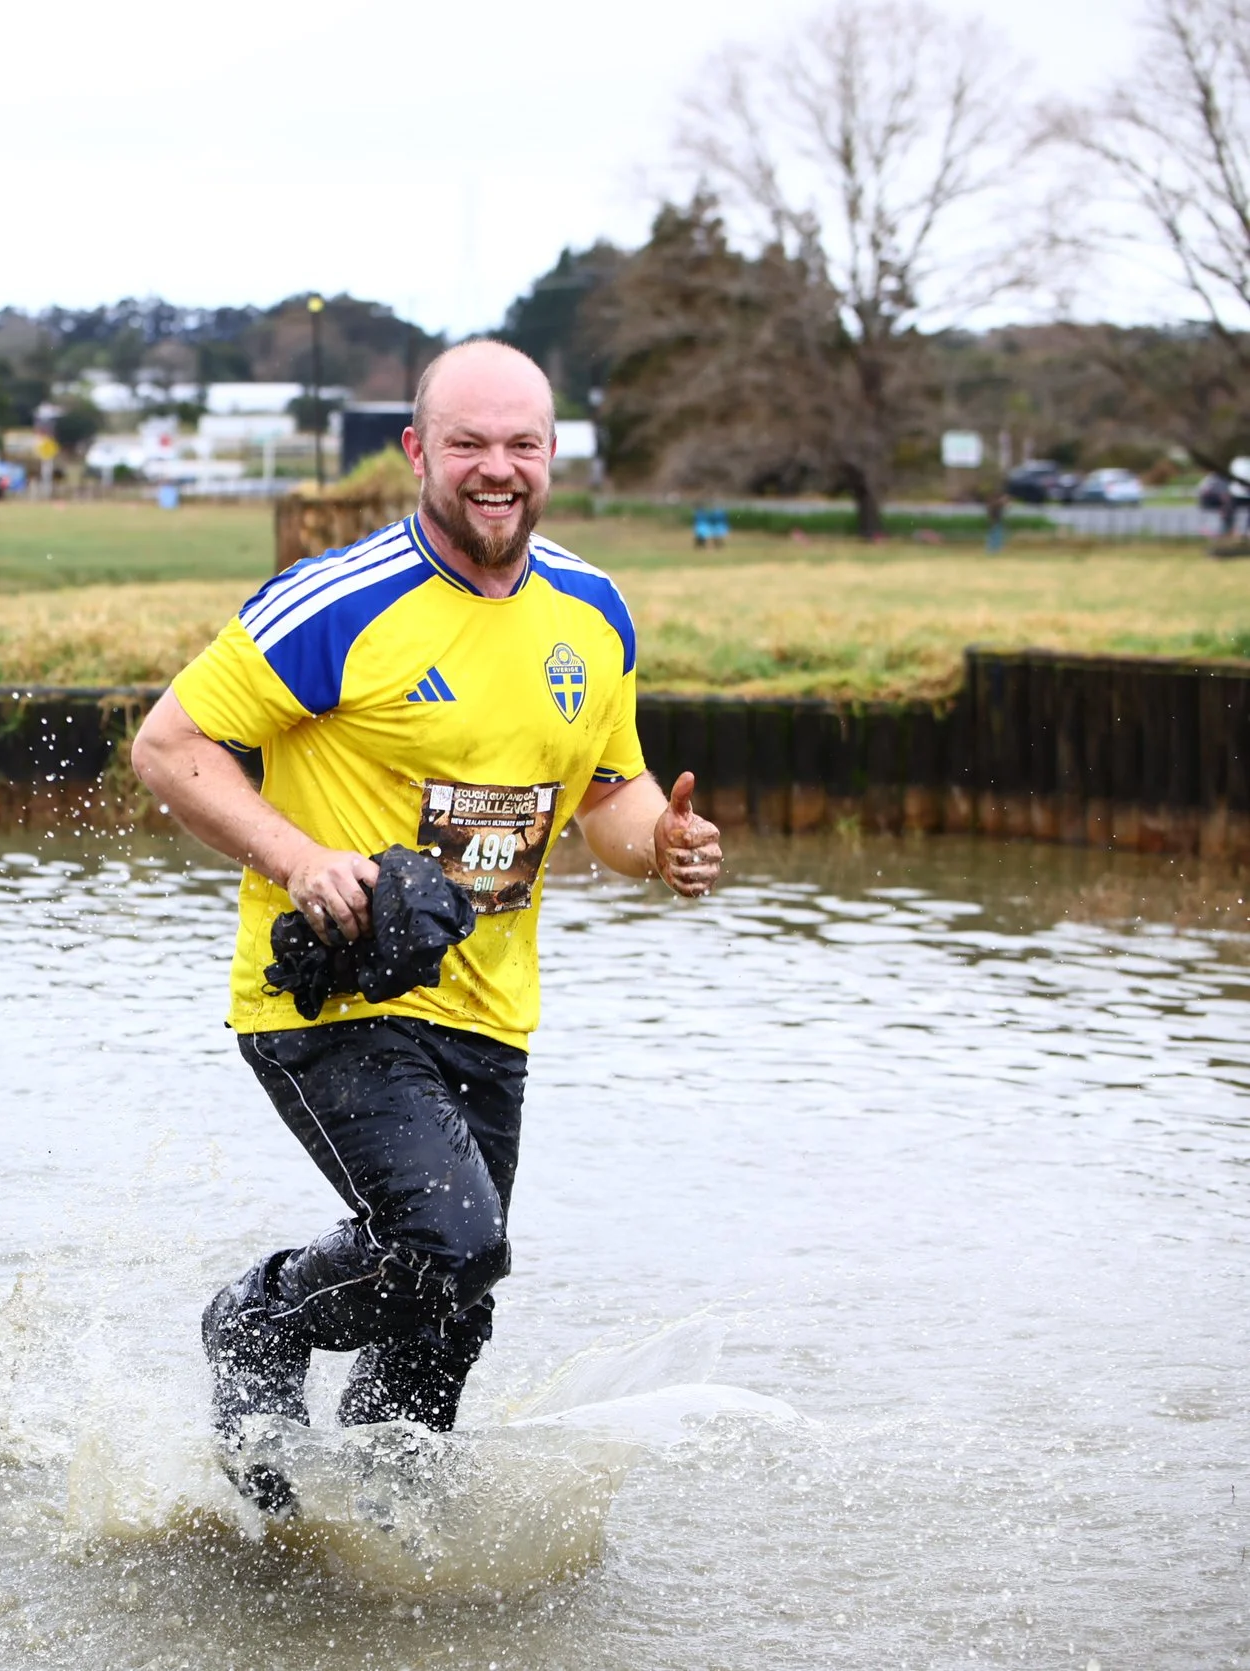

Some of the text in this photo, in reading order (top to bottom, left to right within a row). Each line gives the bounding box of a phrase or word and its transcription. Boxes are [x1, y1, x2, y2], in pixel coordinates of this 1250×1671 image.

[456, 789, 488, 800] TOUGH
[489, 792, 508, 801] GUY
[455, 798, 535, 814] CHALLENGE
[451, 817, 464, 825] NEW
[461, 833, 517, 871] 499
